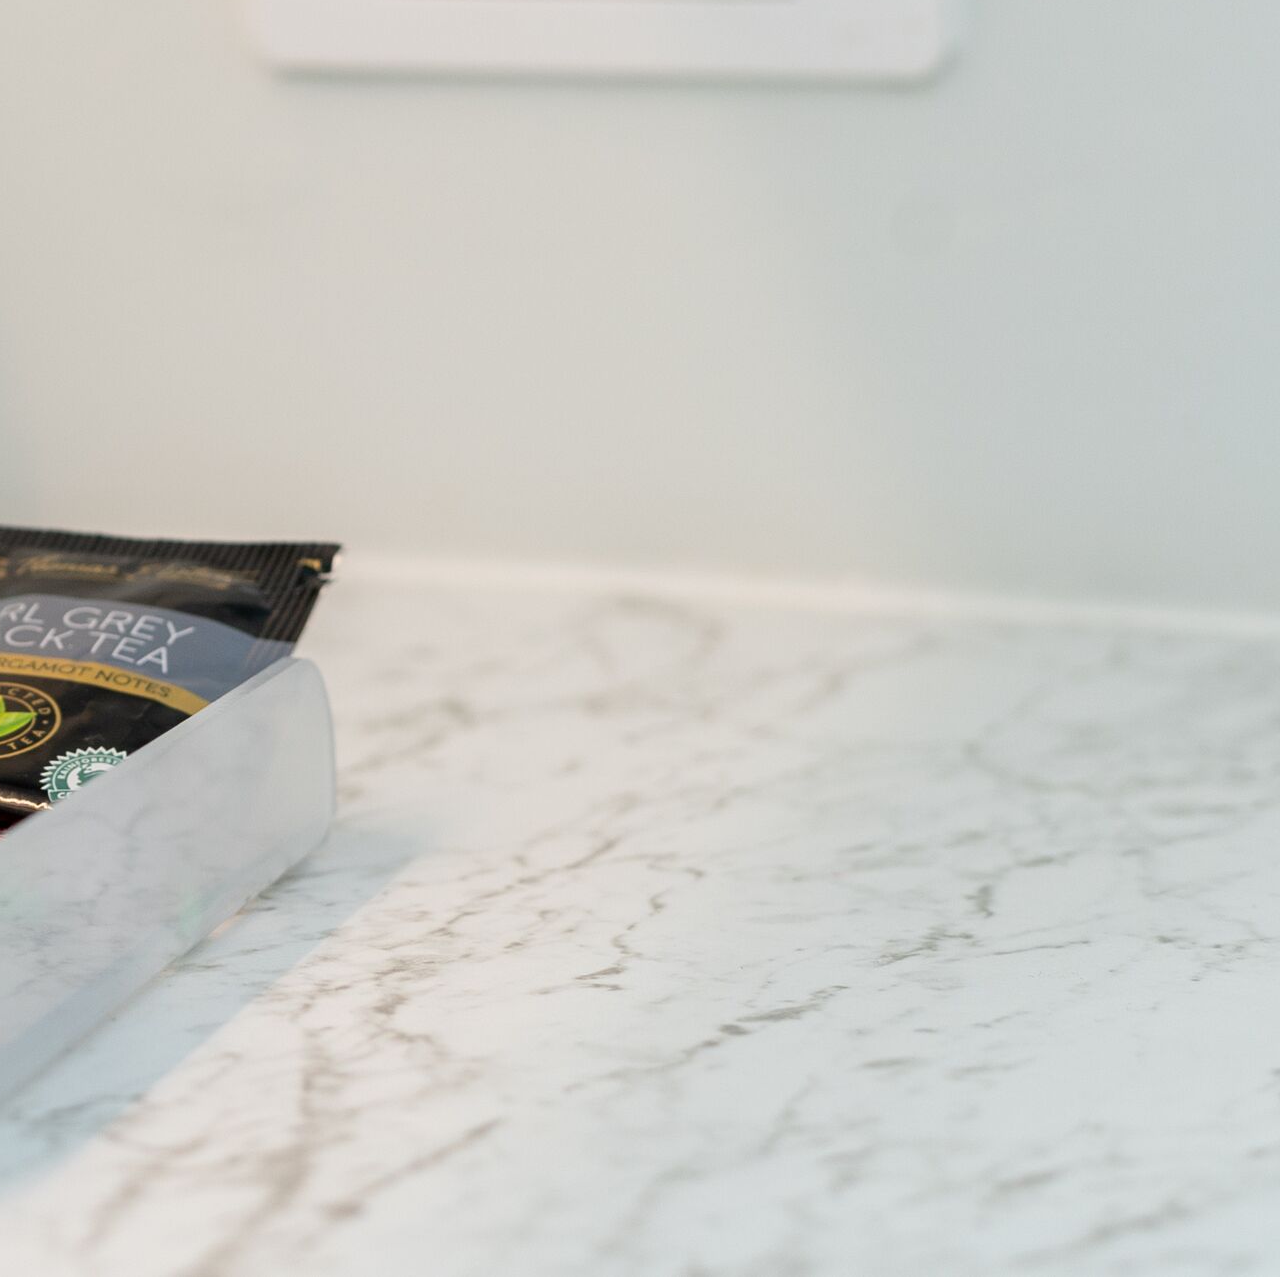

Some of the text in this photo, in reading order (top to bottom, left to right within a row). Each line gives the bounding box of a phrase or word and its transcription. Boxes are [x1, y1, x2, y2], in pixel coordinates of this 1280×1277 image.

[61, 606, 198, 647] GREY
[88, 630, 170, 675] TEA
[93, 667, 173, 700] NOTES
